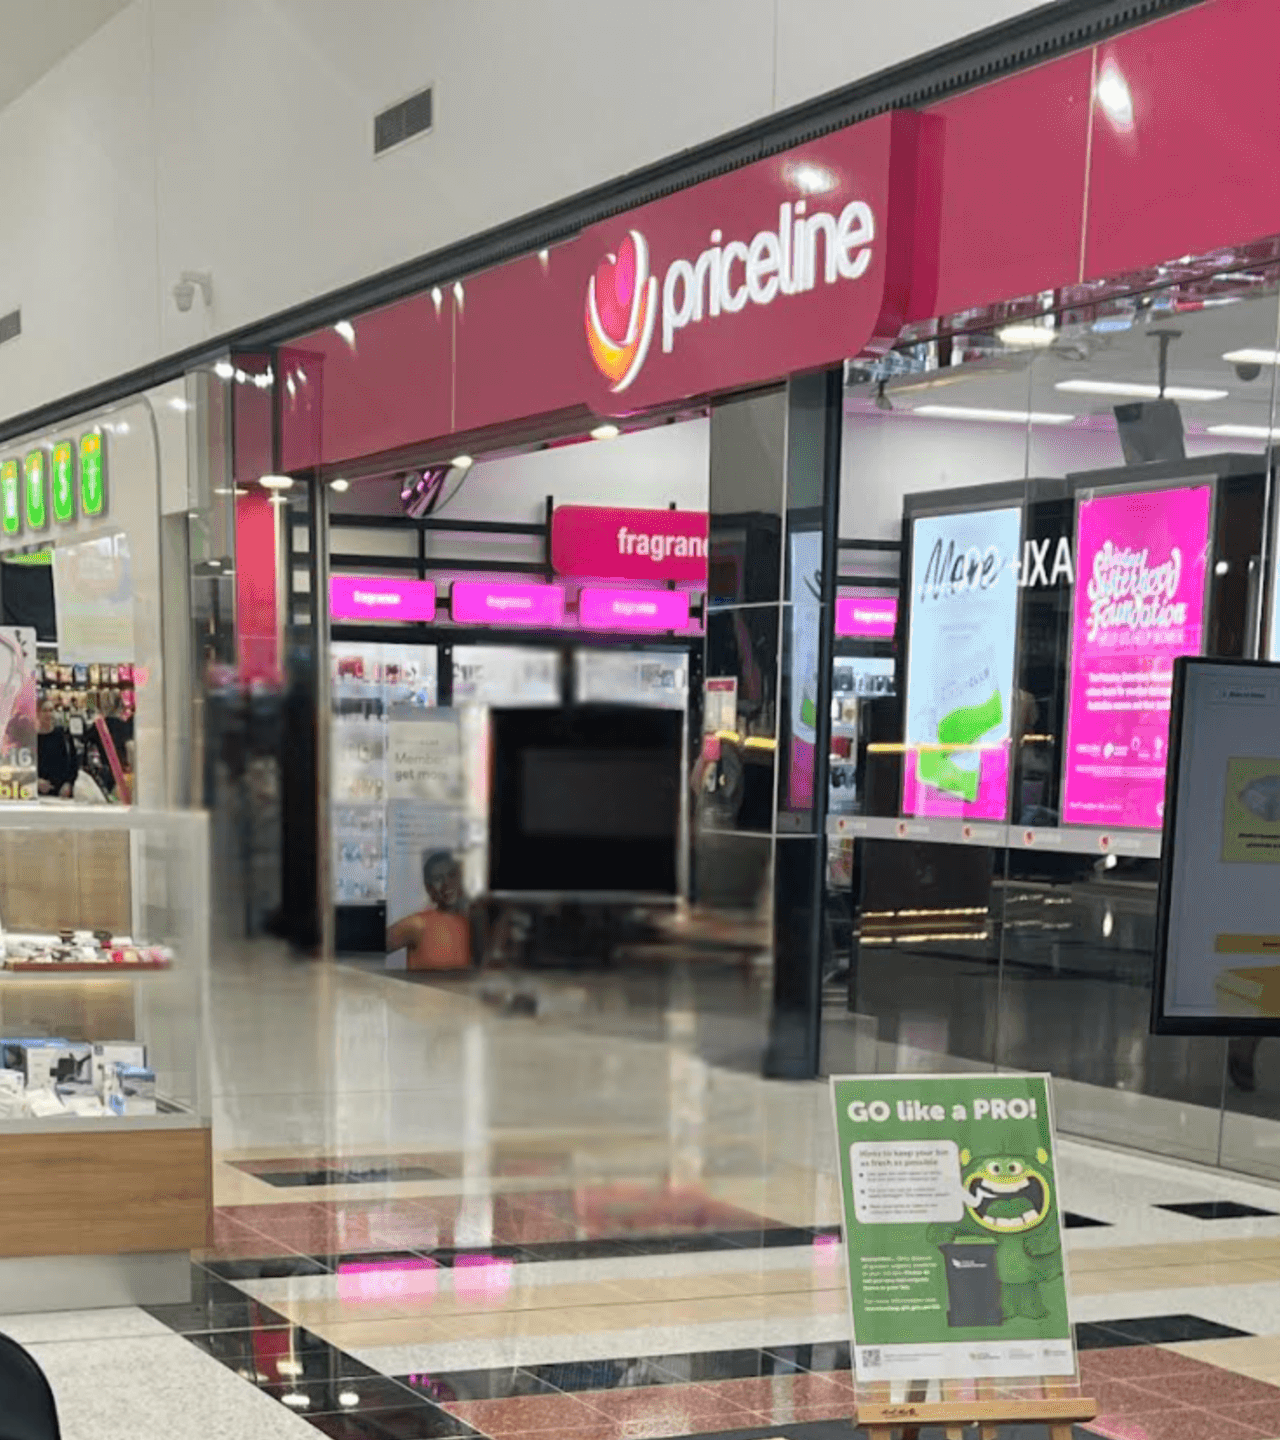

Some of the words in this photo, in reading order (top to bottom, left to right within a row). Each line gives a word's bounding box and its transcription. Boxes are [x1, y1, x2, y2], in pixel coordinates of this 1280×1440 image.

[662, 200, 875, 354] priceline
[846, 1099, 892, 1123] GO
[896, 1099, 946, 1122] like
[951, 1103, 968, 1121] a
[973, 1097, 1038, 1121] PRO!
